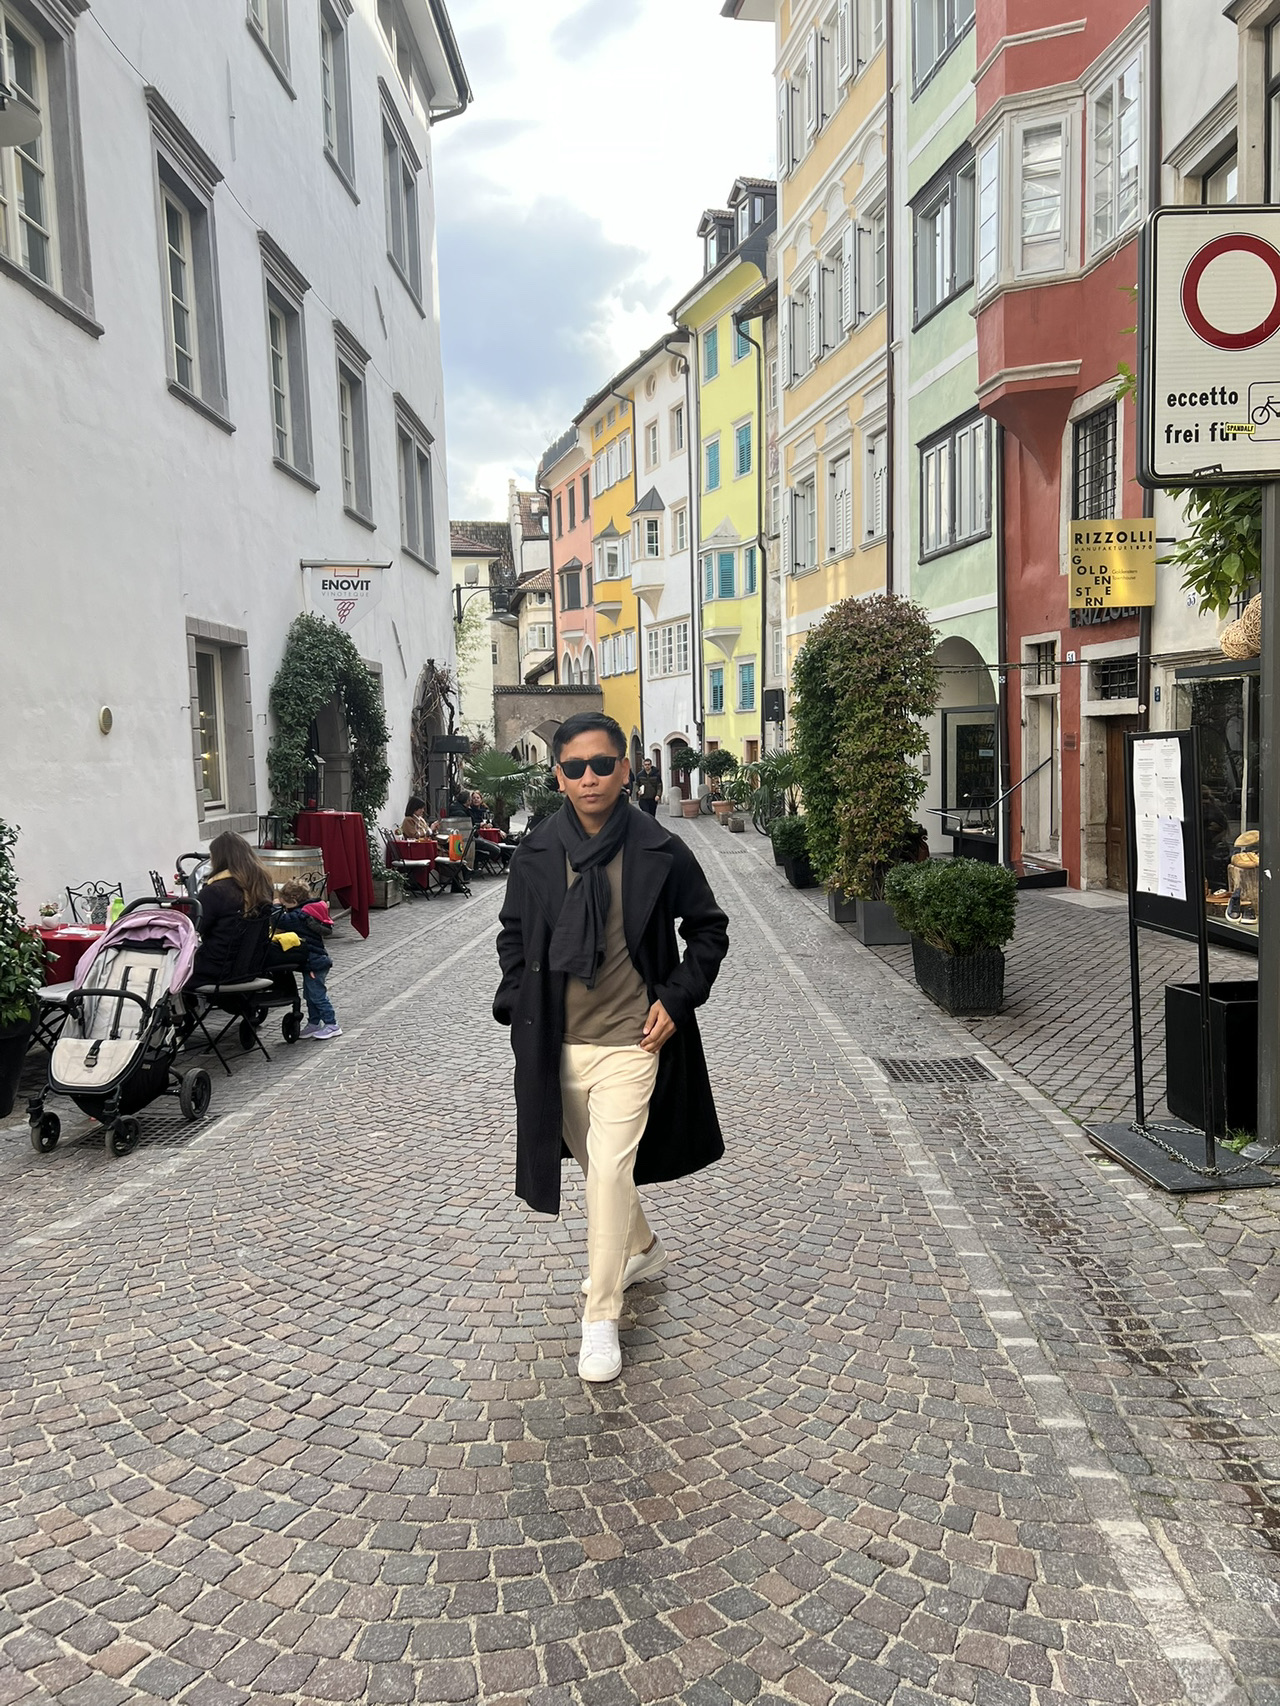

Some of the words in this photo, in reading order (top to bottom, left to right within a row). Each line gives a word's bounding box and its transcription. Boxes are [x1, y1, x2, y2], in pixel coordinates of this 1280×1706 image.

[1167, 386, 1239, 407] eccetto
[1165, 423, 1200, 444] frei
[1075, 531, 1152, 544] RIZZOLLI
[322, 580, 371, 590] ENOVIT
